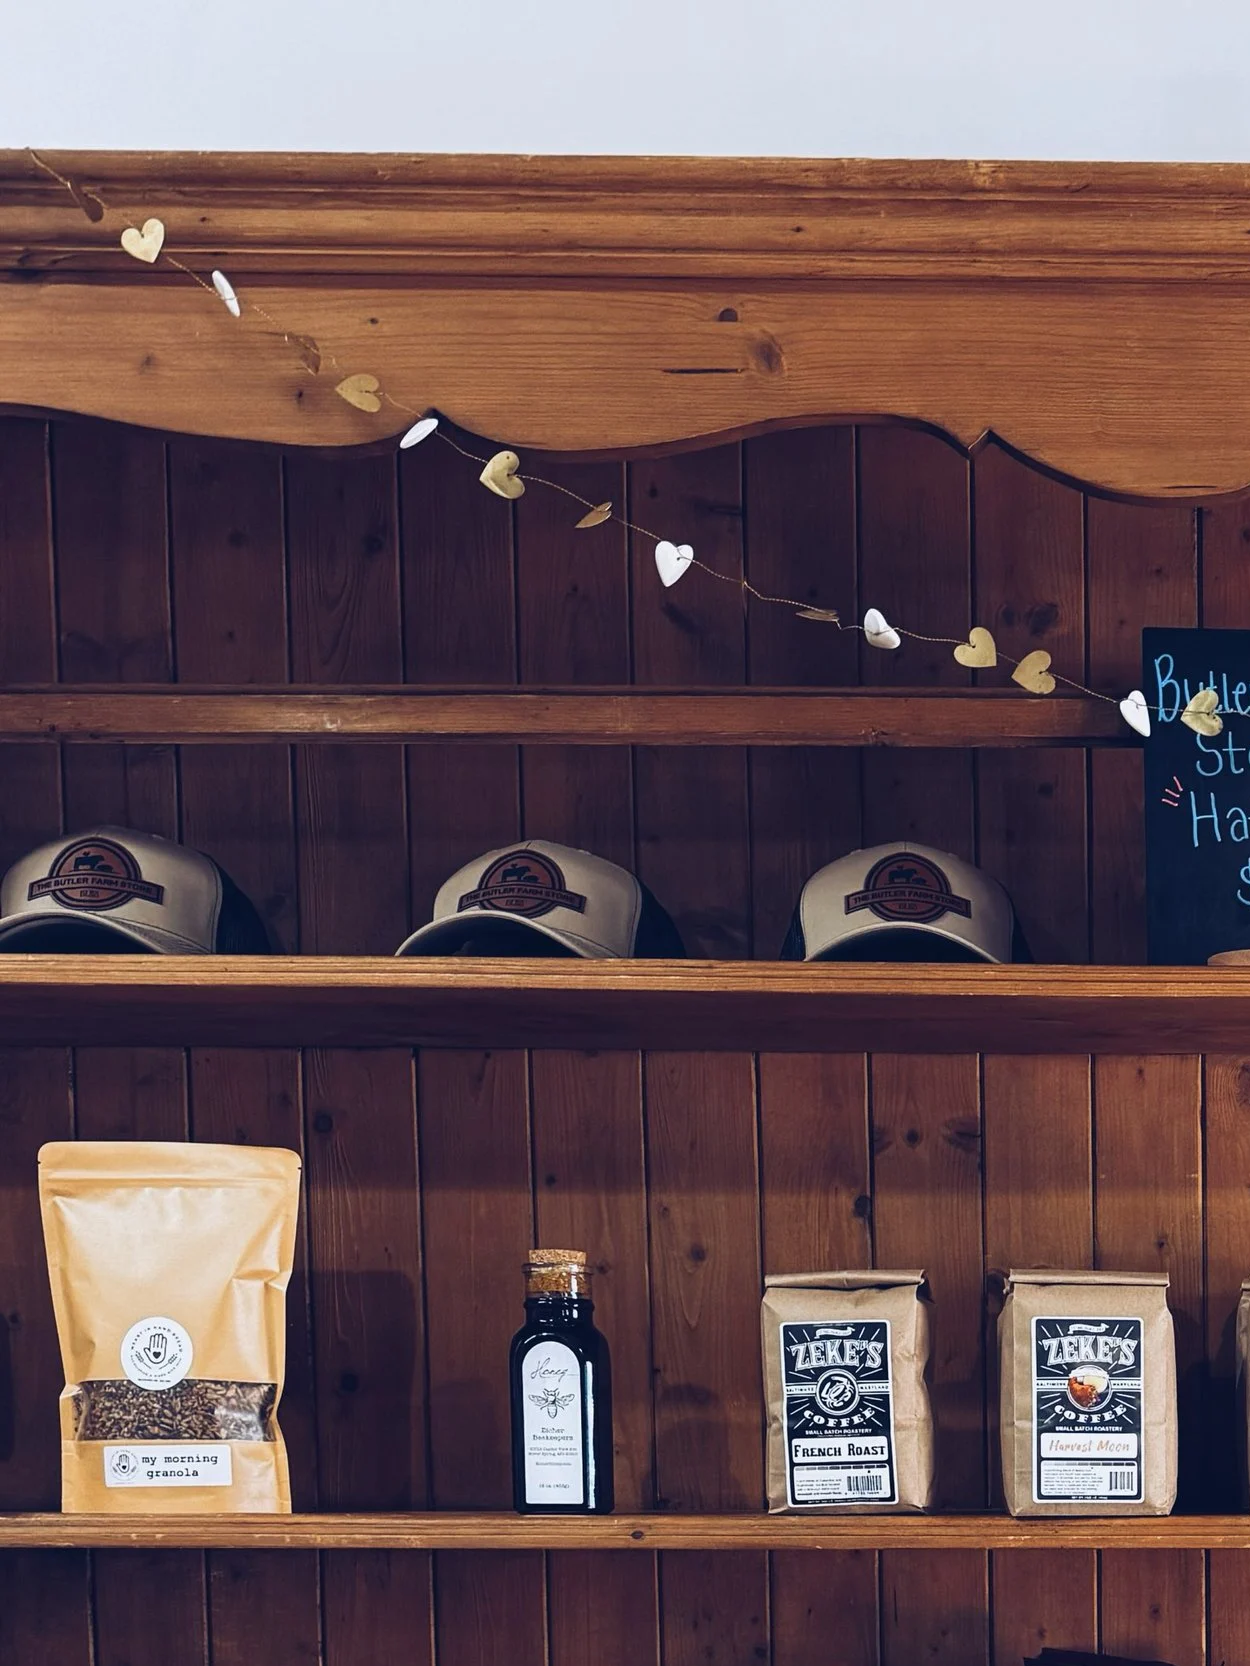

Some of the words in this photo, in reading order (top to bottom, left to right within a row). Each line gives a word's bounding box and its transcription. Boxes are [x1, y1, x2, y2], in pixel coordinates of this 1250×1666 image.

[37, 880, 52, 891] THE
[54, 877, 89, 886] BUTLER
[91, 877, 118, 886] FARM
[120, 882, 152, 893] STORE
[789, 1338, 884, 1371] ZEKE'S
[1042, 1335, 1138, 1366] ZEKE'S
[803, 1407, 875, 1427] COFFEE
[1054, 1404, 1127, 1423] COFFEE
[794, 1445, 841, 1457] FRENCH
[848, 1444, 885, 1456] ROAST
[1049, 1440, 1092, 1452] Harvest
[1097, 1440, 1130, 1452] Moon
[142, 1455, 156, 1465] my
[165, 1454, 218, 1465] morning
[147, 1468, 199, 1479] granola
